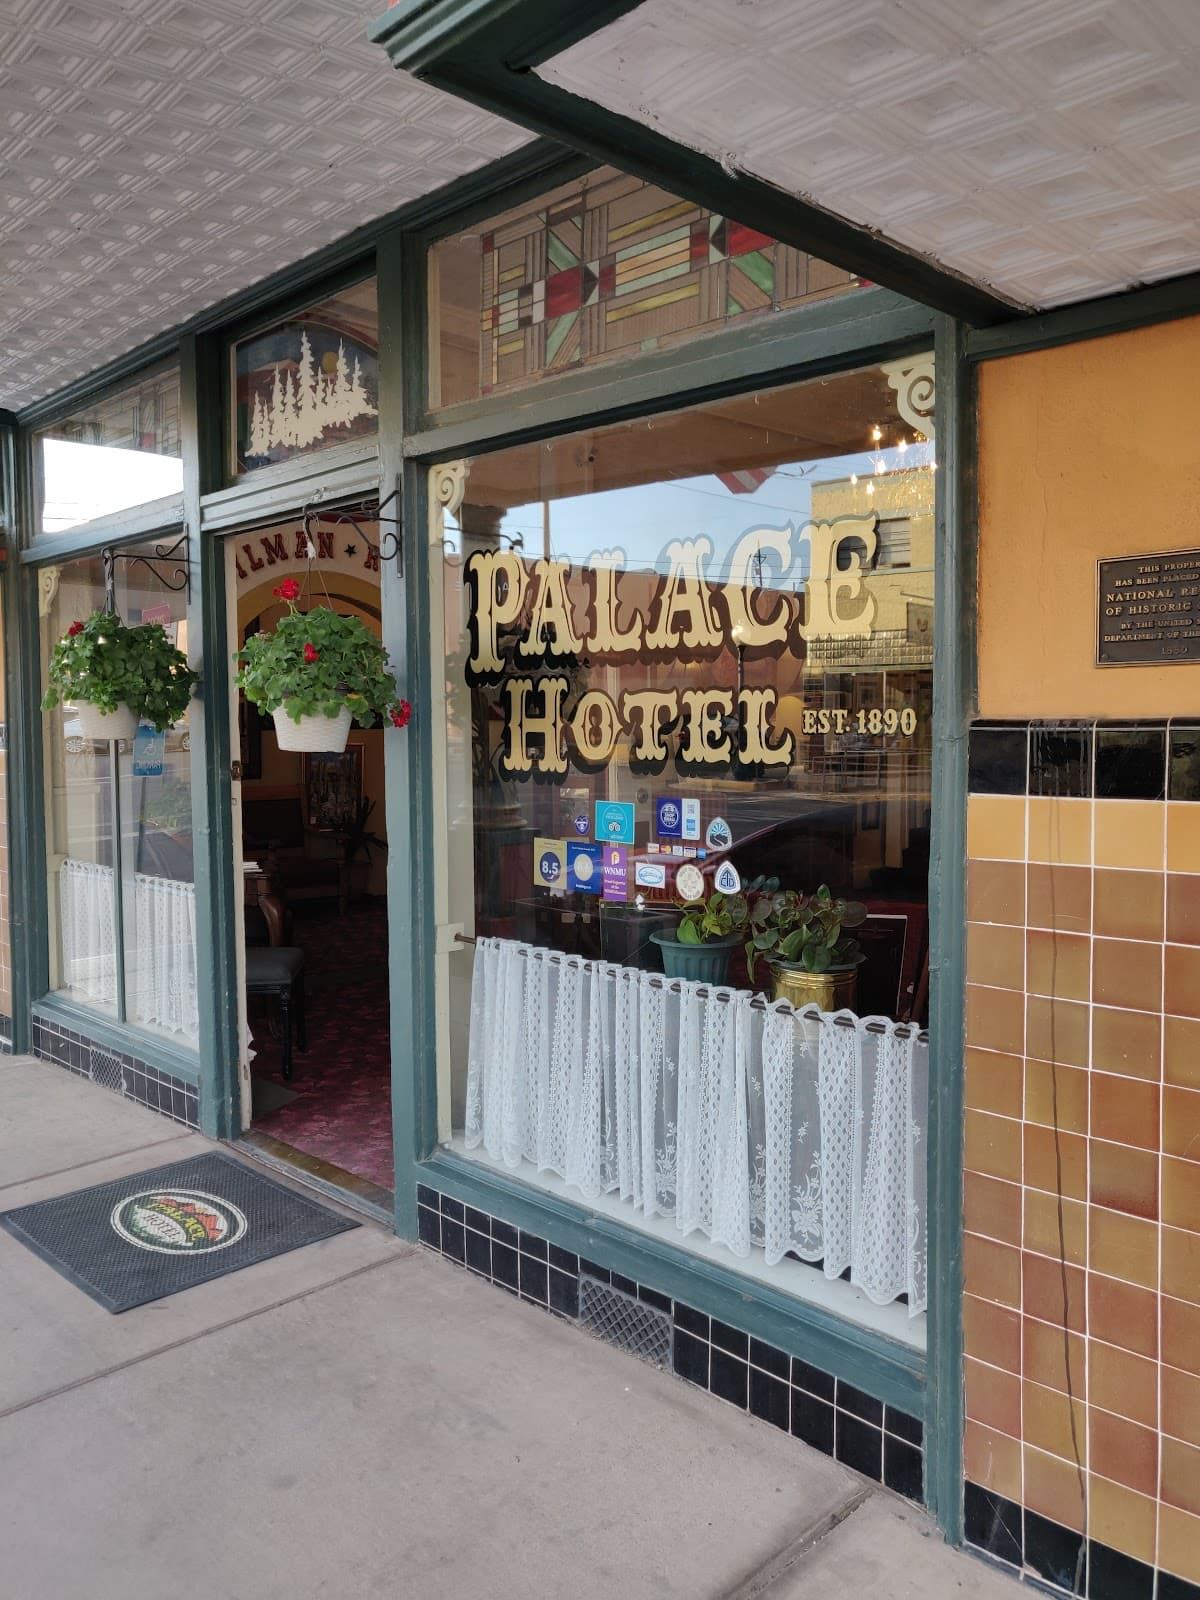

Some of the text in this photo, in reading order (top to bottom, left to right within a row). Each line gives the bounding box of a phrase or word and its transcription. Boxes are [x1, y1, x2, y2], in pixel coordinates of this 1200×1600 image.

[1138, 565, 1160, 574] THIS
[1115, 573, 1199, 588] HAS BEEN PLACED
[465, 511, 879, 687] PALACE
[1106, 586, 1200, 602] NATIONAL RE
[1105, 601, 1192, 616] OF HISTORIC
[1121, 623, 1133, 631] BY
[1136, 620, 1155, 629] THE
[1158, 618, 1193, 628] UNITED
[1167, 631, 1180, 639] OF
[500, 674, 796, 785] HOTEL
[803, 707, 918, 737] EST. 1890
[542, 861, 559, 875] 8.5
[604, 866, 627, 877] WNMU
